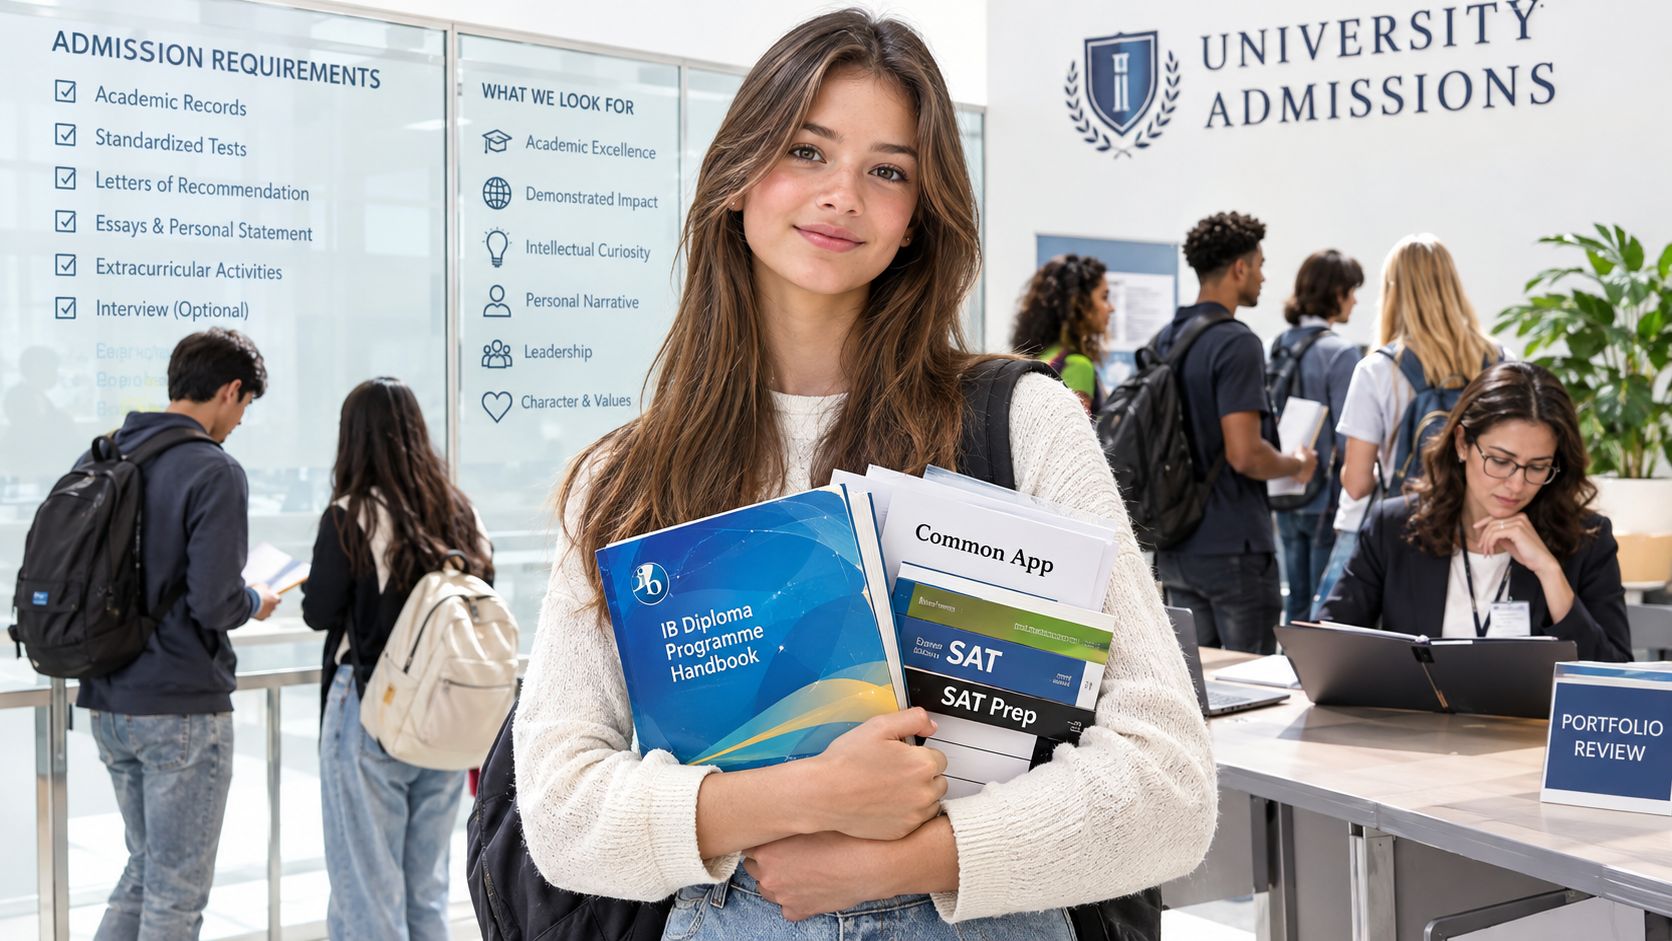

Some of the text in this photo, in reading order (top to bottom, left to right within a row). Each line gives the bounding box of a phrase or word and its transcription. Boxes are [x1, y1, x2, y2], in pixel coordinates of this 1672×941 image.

[1200, 0, 1540, 71] UNIVERSITY
[52, 29, 381, 89] ADMISSION REQUIREMENTS
[95, 85, 247, 116] Academic Records
[482, 82, 634, 115] WHAT WE LOOK FOR
[1205, 61, 1556, 129] ADMISSIONS
[95, 128, 247, 157] Standardized Tests
[526, 135, 656, 159] Academic Excellence
[95, 172, 309, 201] Letters of Recommendation
[526, 187, 658, 211] Demonstrated Impact
[96, 215, 312, 241] Essays & Personal Statement
[526, 240, 650, 262] Intellectual Curiosity
[96, 259, 282, 280] Extracurricular Activities
[96, 300, 249, 321] Interview (Optional)
[526, 293, 639, 309] Personal Narrative
[525, 344, 593, 362] Leadership
[521, 393, 631, 409] Character & Values
[915, 523, 1054, 577] Common App
[660, 603, 753, 639] IB Diploma
[665, 623, 764, 662] Programme
[946, 640, 1003, 673] SAT
[671, 648, 760, 683] Handbook
[941, 686, 987, 712] SAT
[989, 696, 1037, 728] Prep
[1562, 714, 1663, 737] PORTFOLIO
[1574, 741, 1646, 761] REVIEW
